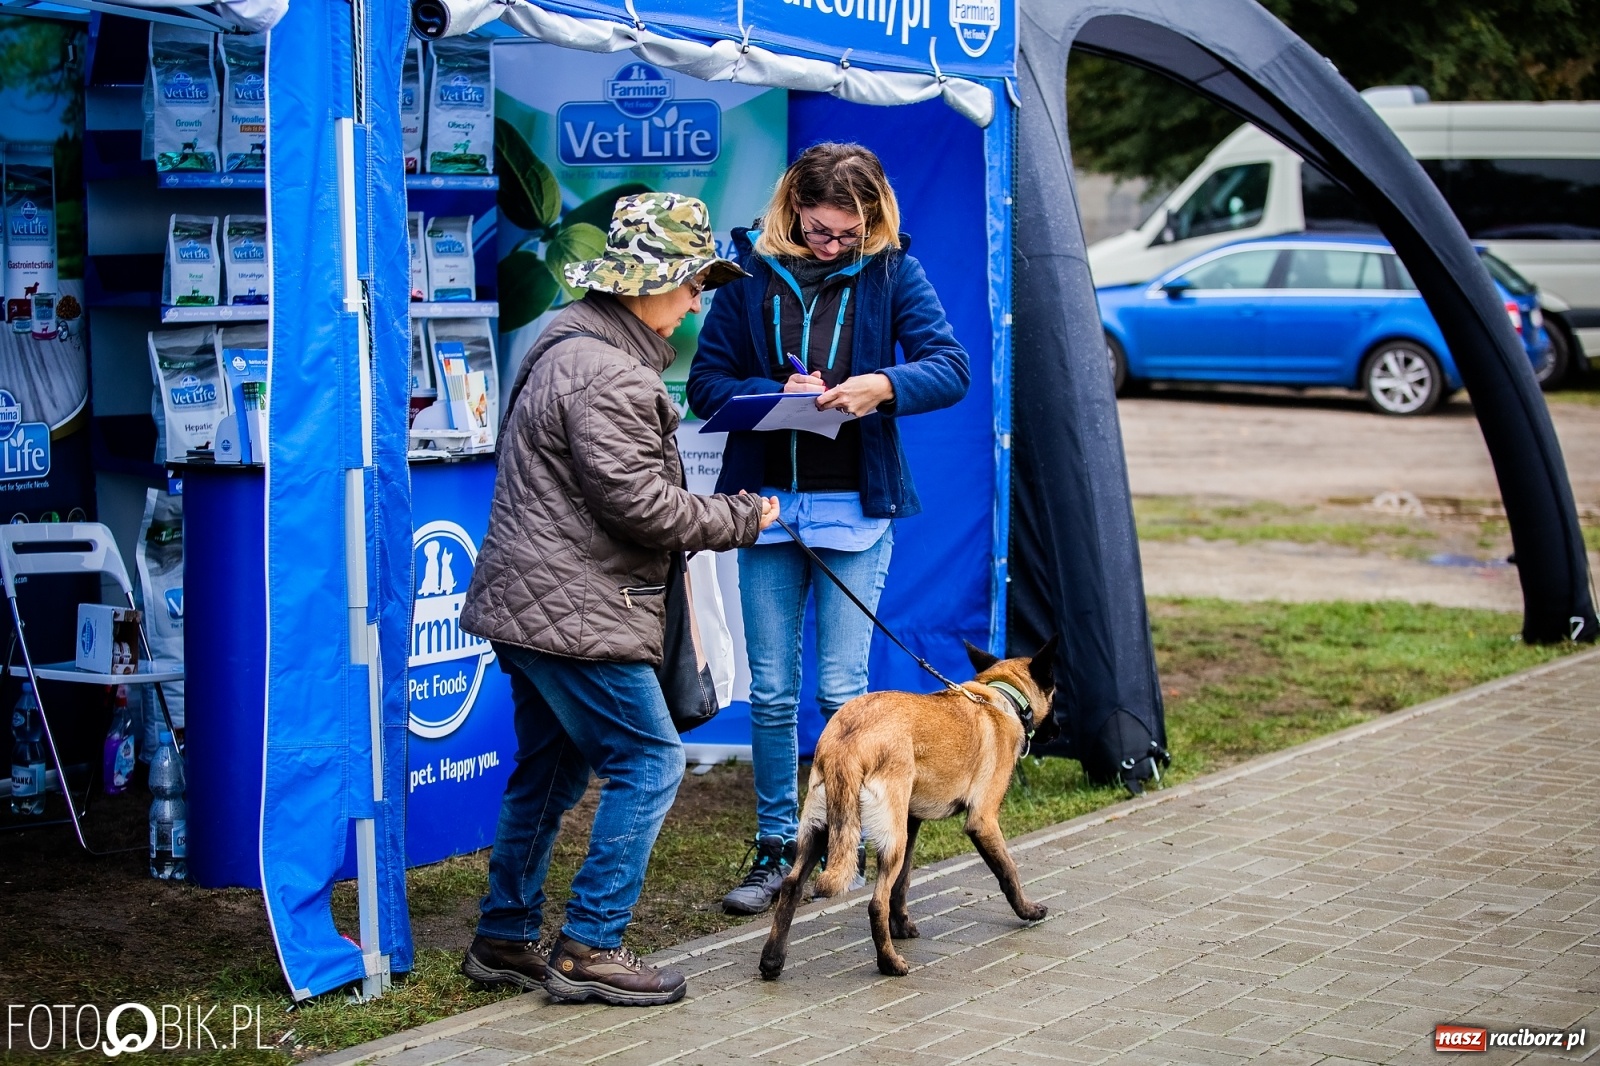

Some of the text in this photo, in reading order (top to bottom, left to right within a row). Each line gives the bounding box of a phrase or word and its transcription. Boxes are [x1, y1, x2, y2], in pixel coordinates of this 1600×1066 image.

[955, 0, 994, 21] Farmina
[164, 87, 207, 99] Vet Life
[235, 87, 258, 100] Vet
[442, 88, 483, 102] Vet Life
[611, 82, 667, 97] Farmina
[175, 119, 202, 128] Growth
[231, 114, 265, 124] Hypoaller
[447, 121, 475, 131] Obesity
[564, 118, 712, 159] Vet Life
[598, 170, 628, 179] Natural
[662, 169, 691, 180] Special
[692, 168, 718, 178] Needs
[12, 219, 47, 235] Vet Life
[180, 249, 208, 259] Vet Life
[234, 249, 264, 259] Vet Life
[7, 260, 54, 270] Gastrointestinal
[172, 389, 216, 405] Vet Life
[184, 422, 213, 433] Hepatic
[4, 438, 45, 473] Life
[15, 481, 33, 492] Specific
[34, 480, 50, 489] Needs
[409, 670, 467, 701] Pet Foods
[409, 750, 500, 793] pet. Happy you.
